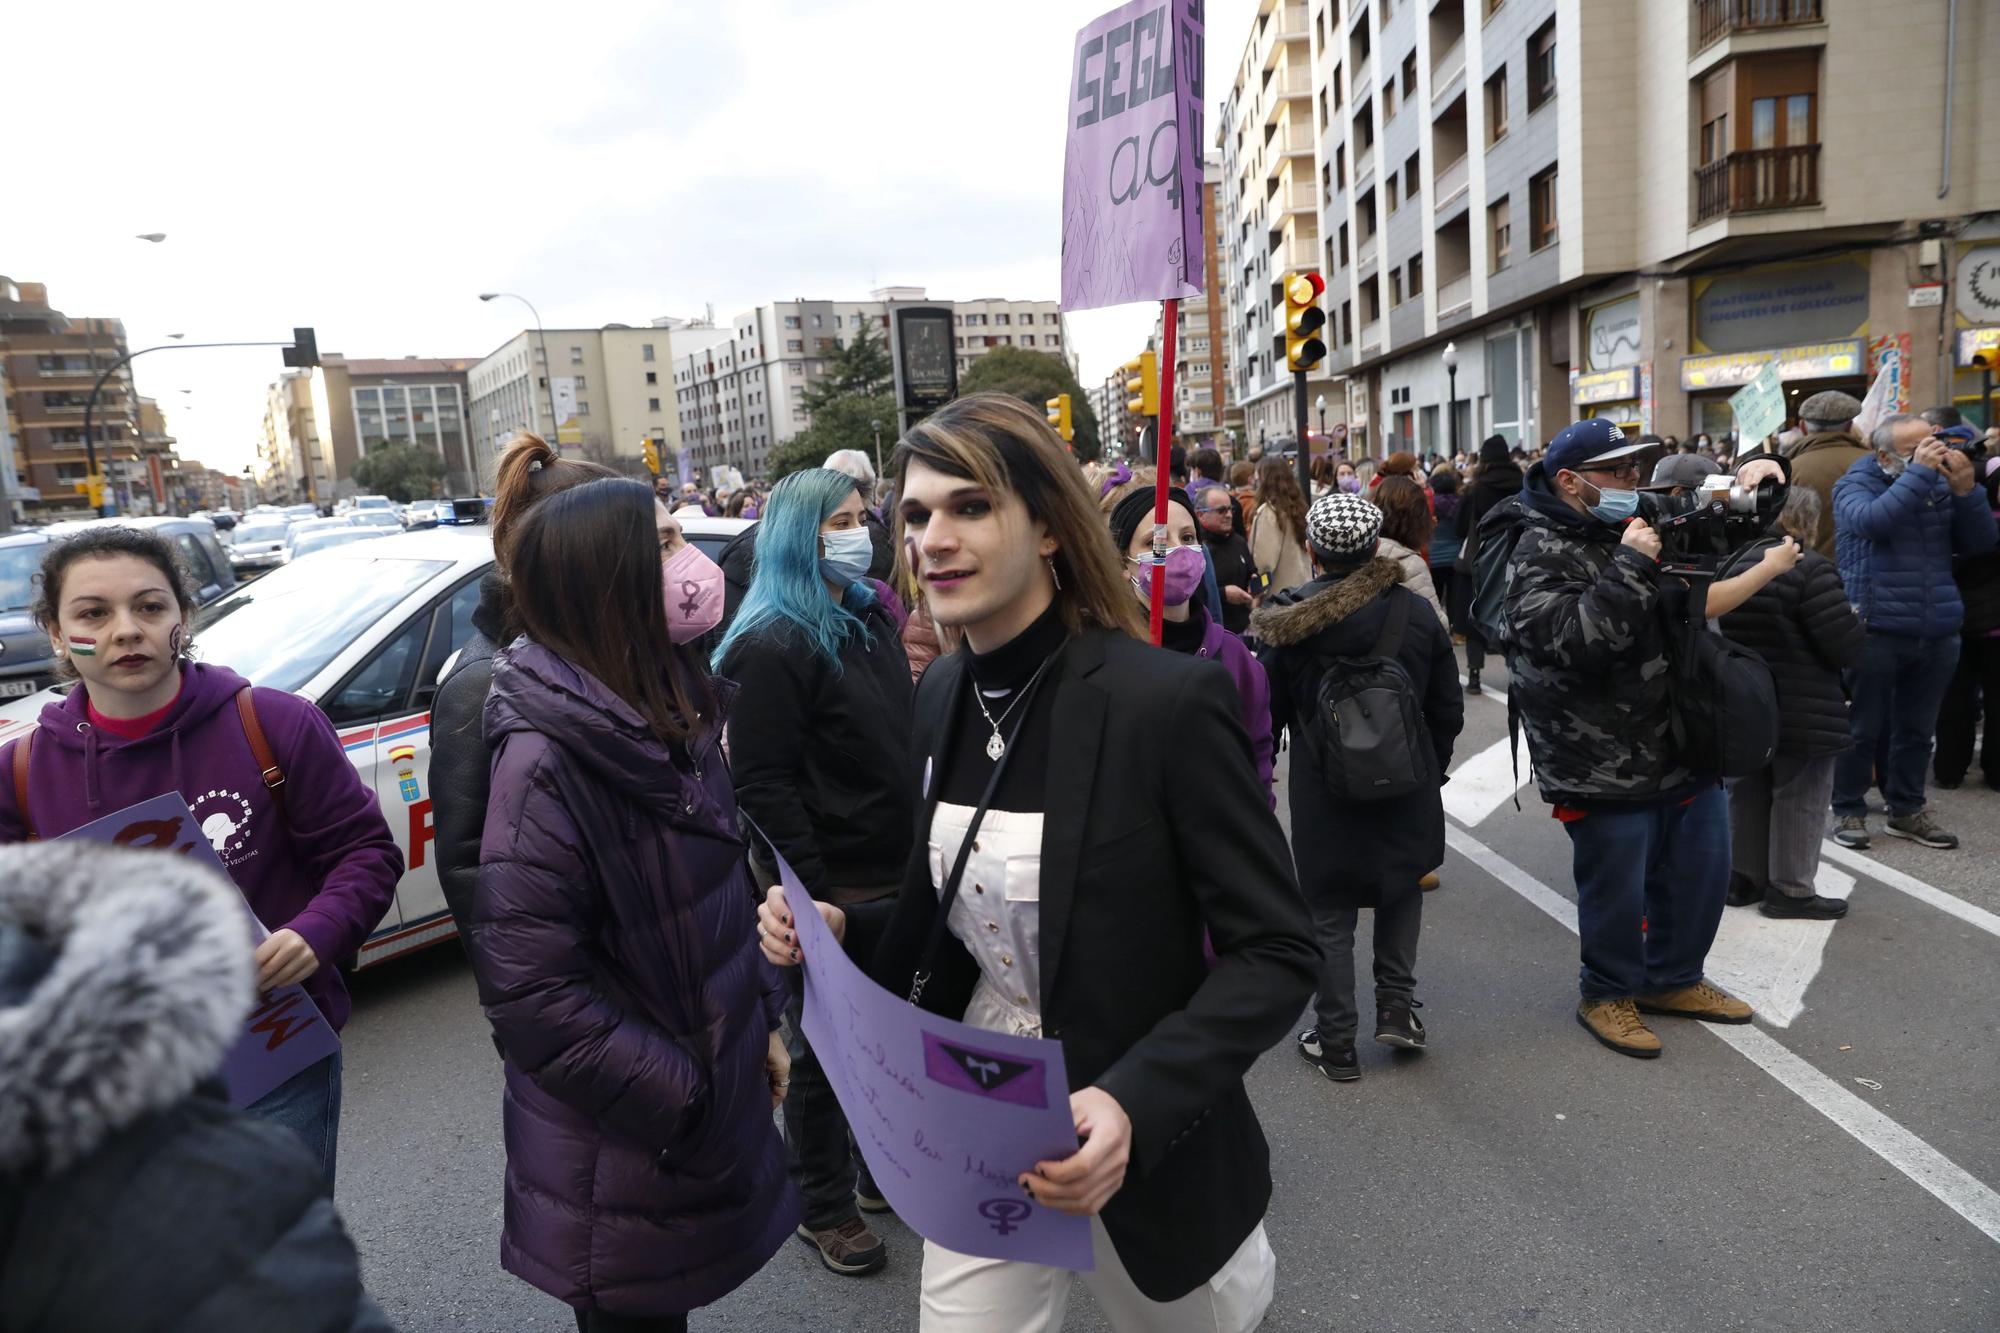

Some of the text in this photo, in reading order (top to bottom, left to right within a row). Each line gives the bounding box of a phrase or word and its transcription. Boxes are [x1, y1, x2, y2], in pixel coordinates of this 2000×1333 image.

[1776, 281, 1835, 299] ESCOLAR
[1710, 305, 1768, 323] JUGUETES
[1771, 303, 1788, 315] DE
[230, 848, 259, 866] VIOLETAS
